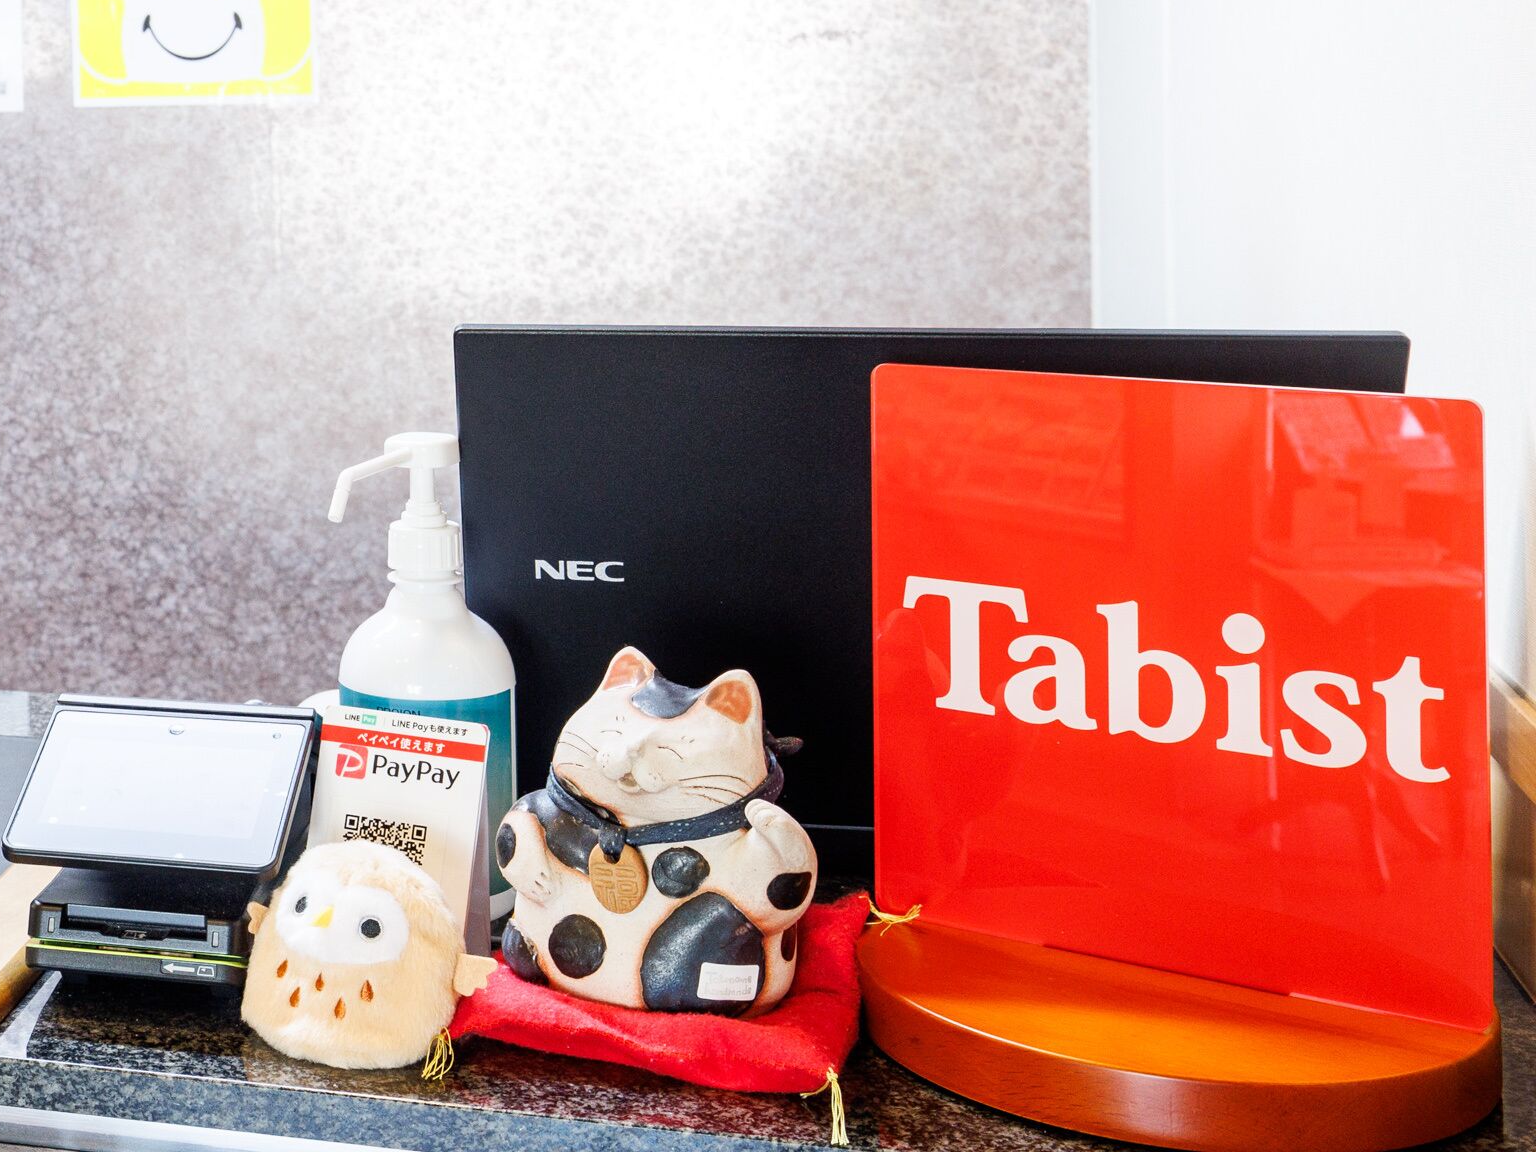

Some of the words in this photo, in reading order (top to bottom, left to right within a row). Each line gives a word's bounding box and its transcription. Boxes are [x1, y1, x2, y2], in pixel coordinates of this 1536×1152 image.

[534, 559, 625, 583] NEC
[902, 575, 1451, 784] Tabist
[344, 713, 361, 722] LINE
[391, 719, 411, 729] LINE
[357, 732, 446, 754] ペイペイ使えます
[372, 753, 461, 790] PayPay
